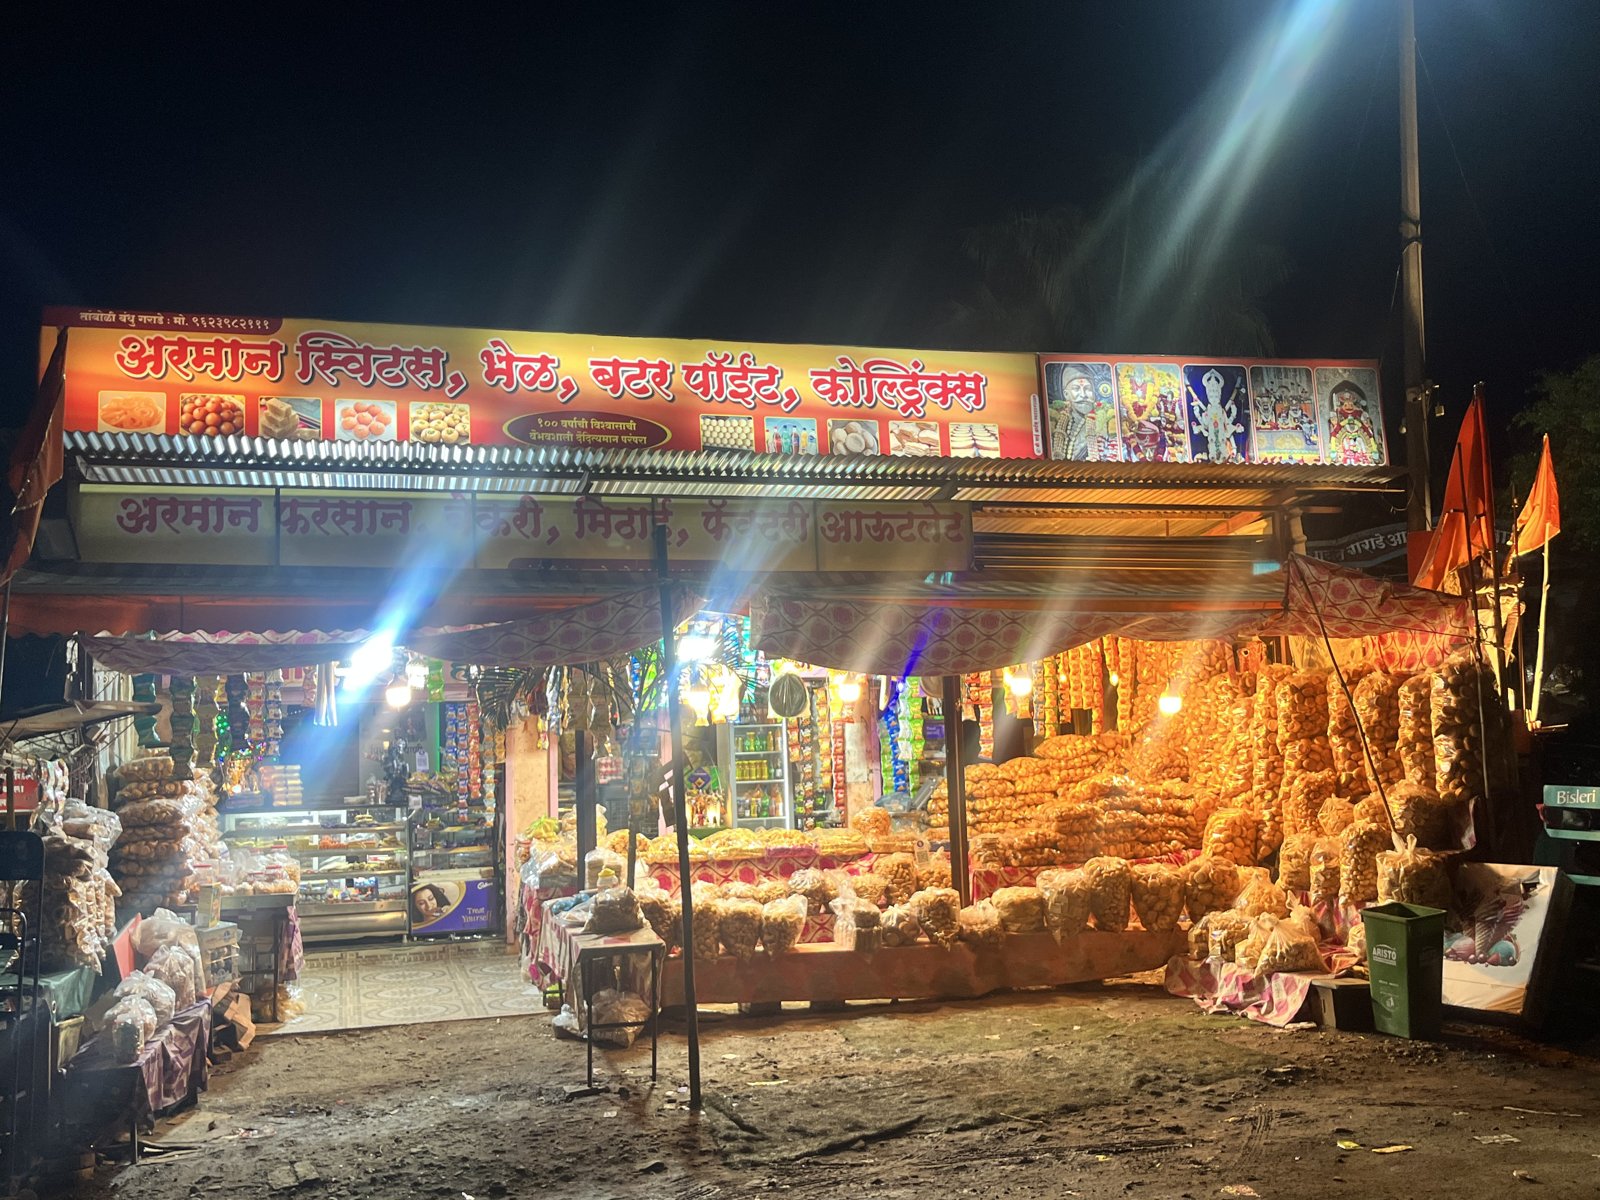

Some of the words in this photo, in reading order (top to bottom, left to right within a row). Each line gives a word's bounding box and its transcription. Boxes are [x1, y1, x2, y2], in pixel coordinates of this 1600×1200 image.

[138, 312, 164, 325] गराडे
[115, 333, 286, 382] अरमान
[294, 331, 467, 398] स्विटस,
[479, 338, 578, 403] भेळ,
[588, 356, 675, 401] बटर
[680, 351, 800, 412] पॉईंट,
[808, 355, 987, 417] कोल्ड्रिंक्स
[117, 495, 262, 535] अरमान
[820, 501, 965, 545] आऊटलेट
[1556, 789, 1597, 805] Bisleri
[1372, 946, 1397, 961] ARISTO
